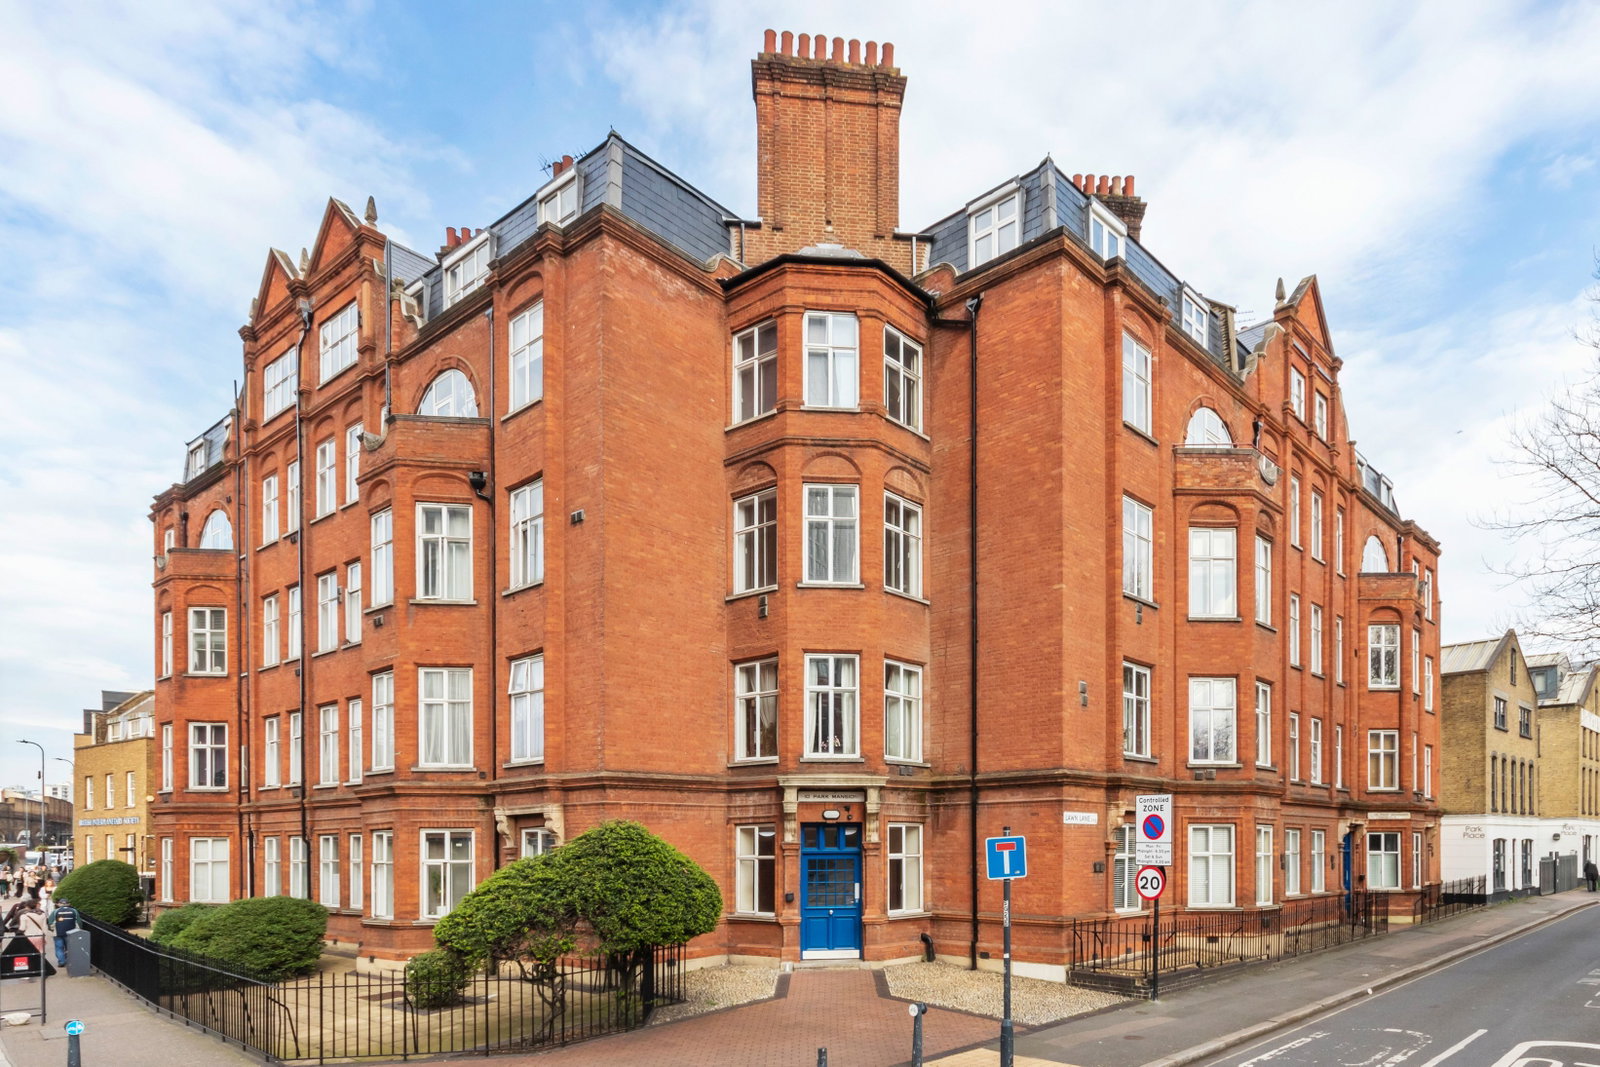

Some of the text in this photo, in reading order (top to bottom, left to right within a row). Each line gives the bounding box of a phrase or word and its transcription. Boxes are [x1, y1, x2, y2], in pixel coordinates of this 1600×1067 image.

[1143, 804, 1165, 812] ZONE
[1065, 813, 1079, 821] LAWN
[1079, 814, 1091, 823] LANE
[1464, 825, 1483, 833] Park
[1462, 831, 1486, 839] Place
[1139, 876, 1160, 890] 20
